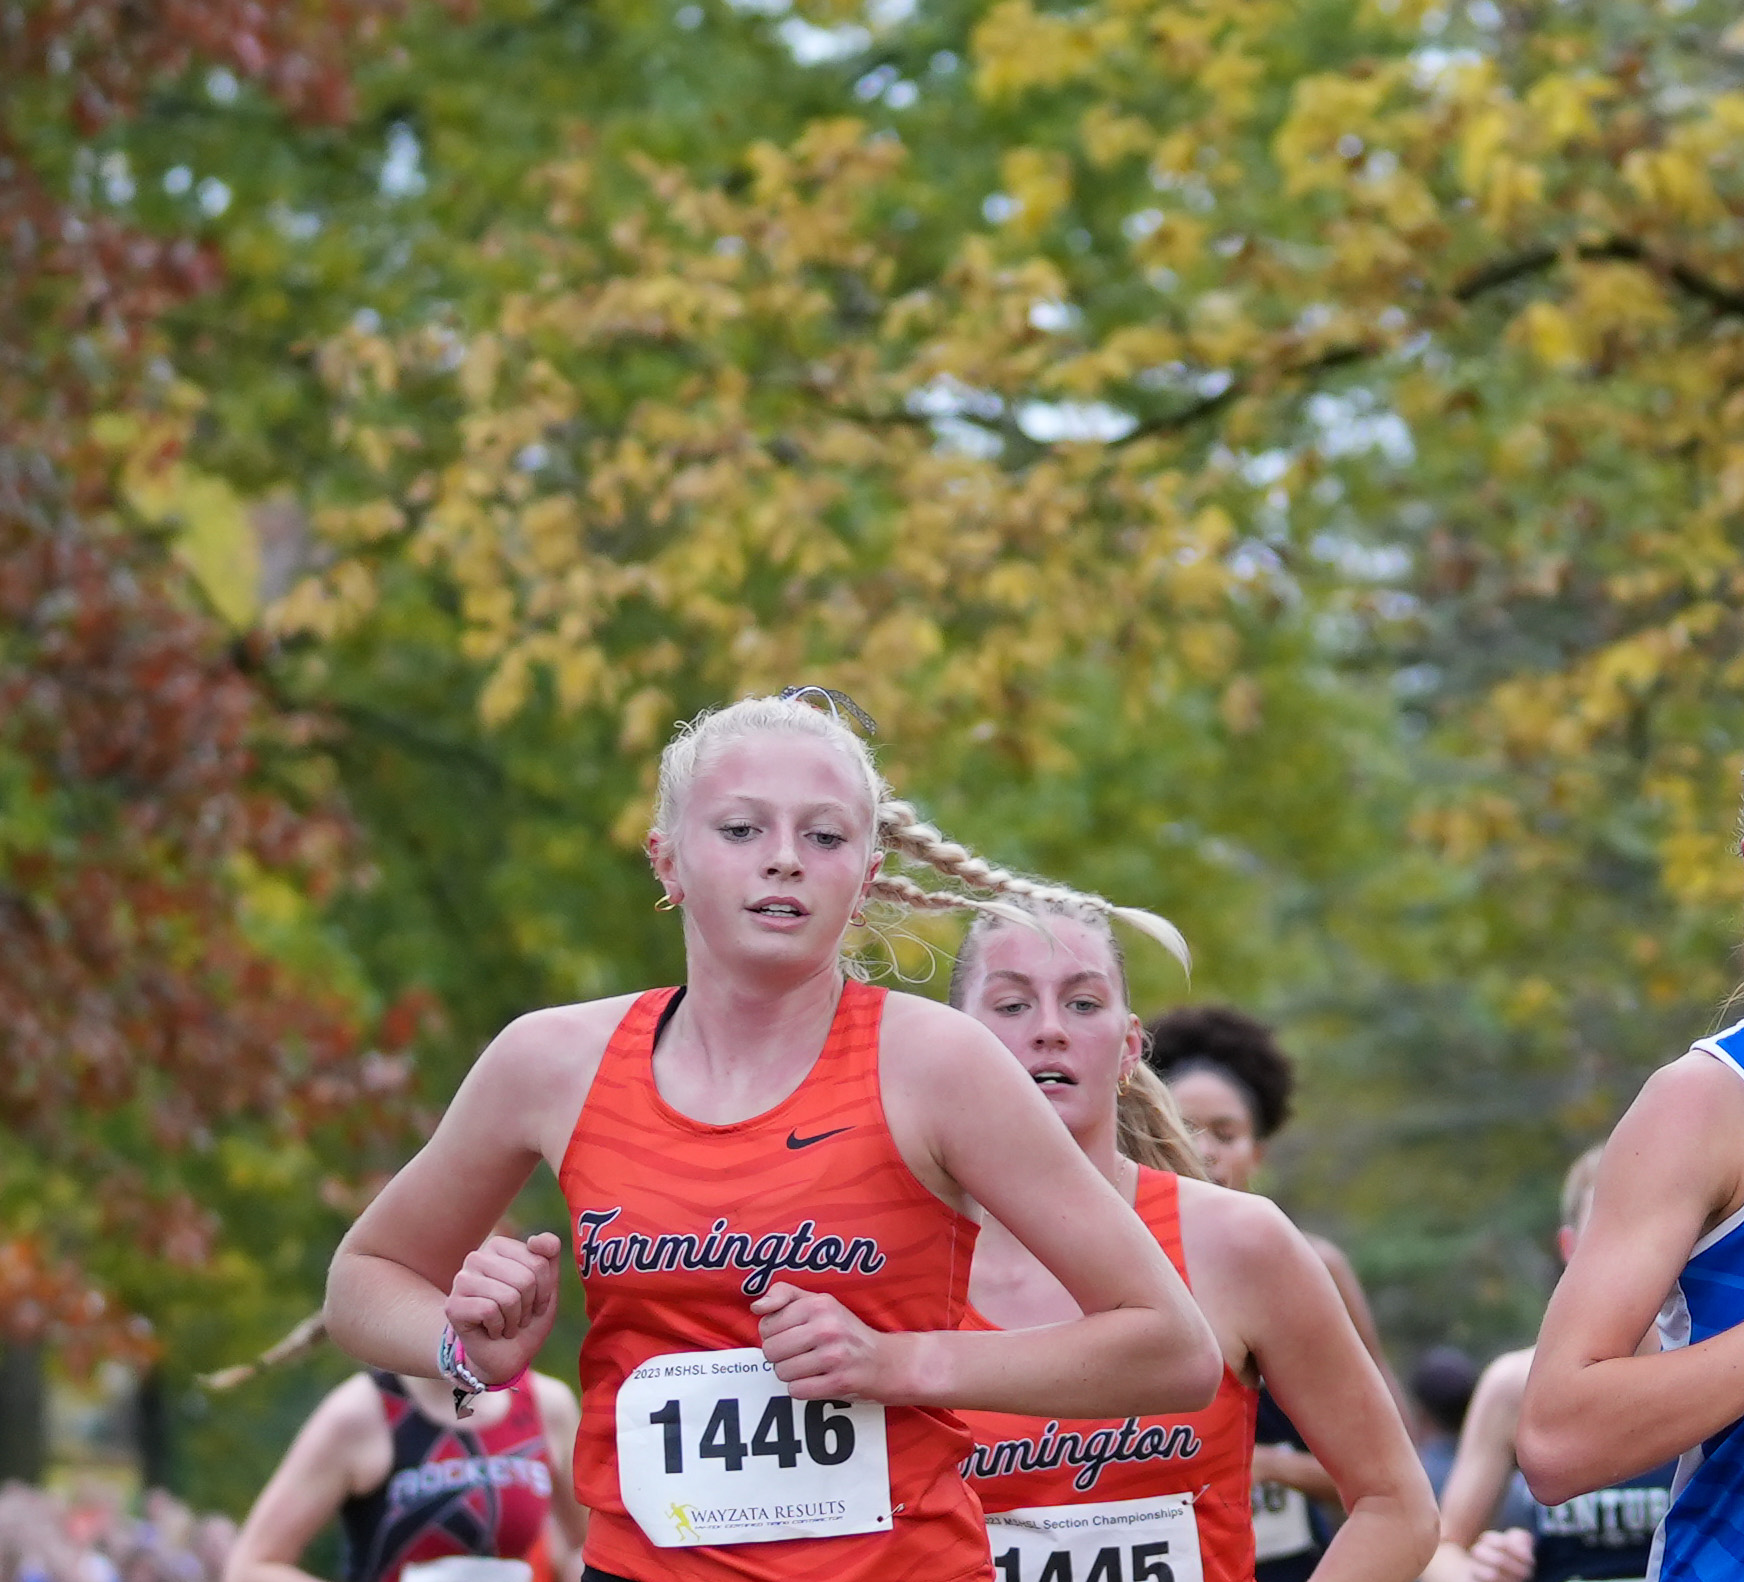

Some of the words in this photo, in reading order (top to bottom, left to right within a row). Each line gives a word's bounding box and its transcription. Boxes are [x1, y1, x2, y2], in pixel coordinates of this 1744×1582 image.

[578, 1206, 886, 1296] Farmington
[634, 1367, 661, 1380] 2023
[664, 1364, 708, 1377] MSHSL
[711, 1361, 758, 1374] Section
[650, 1396, 855, 1474] 1446
[957, 1417, 1201, 1491] rmington
[691, 1507, 770, 1523] WAYZATA
[774, 1500, 846, 1519] RESULTS
[1043, 1515, 1089, 1529] Section
[1092, 1507, 1184, 1526] Championships
